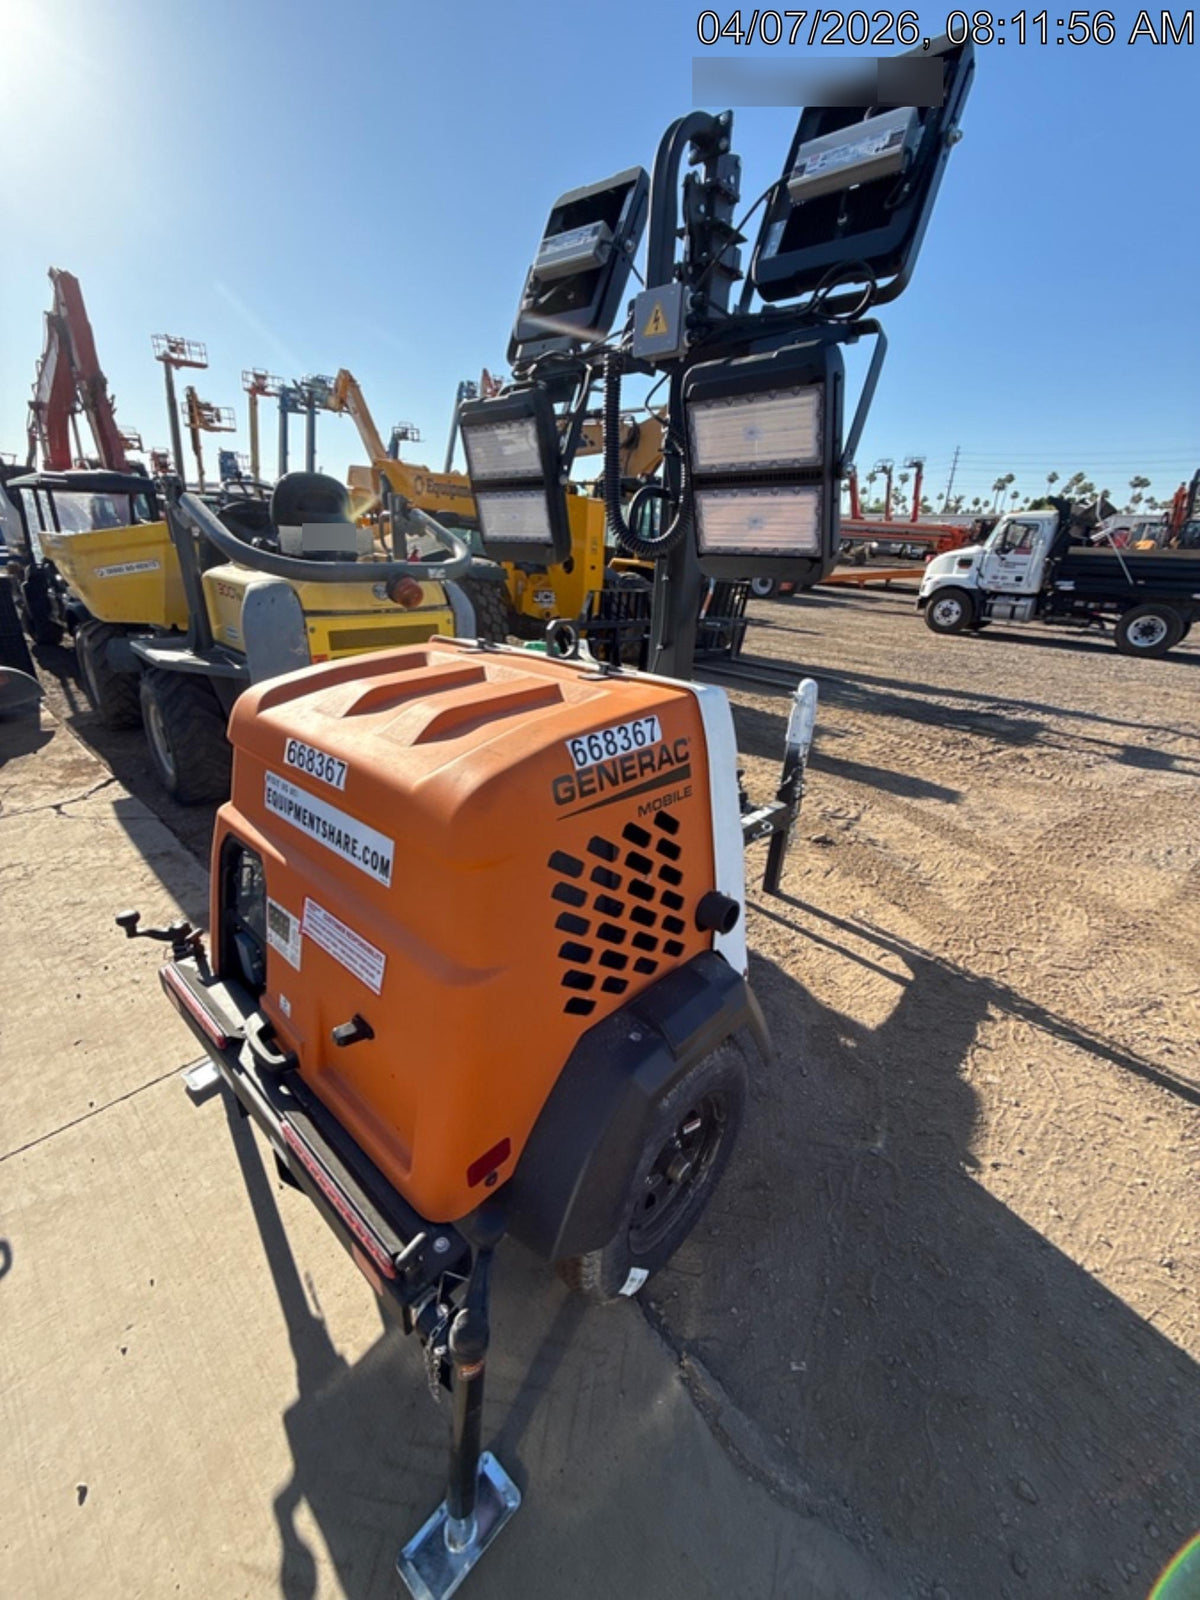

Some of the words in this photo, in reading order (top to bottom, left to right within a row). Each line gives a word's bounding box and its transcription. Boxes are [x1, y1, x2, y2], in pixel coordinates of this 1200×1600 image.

[287, 740, 346, 787] 668367
[570, 716, 657, 768] 668367
[552, 738, 690, 806] GENERAC
[638, 785, 693, 818] MOBILE
[266, 787, 391, 879] EQUIPMENTSHARE.COM
